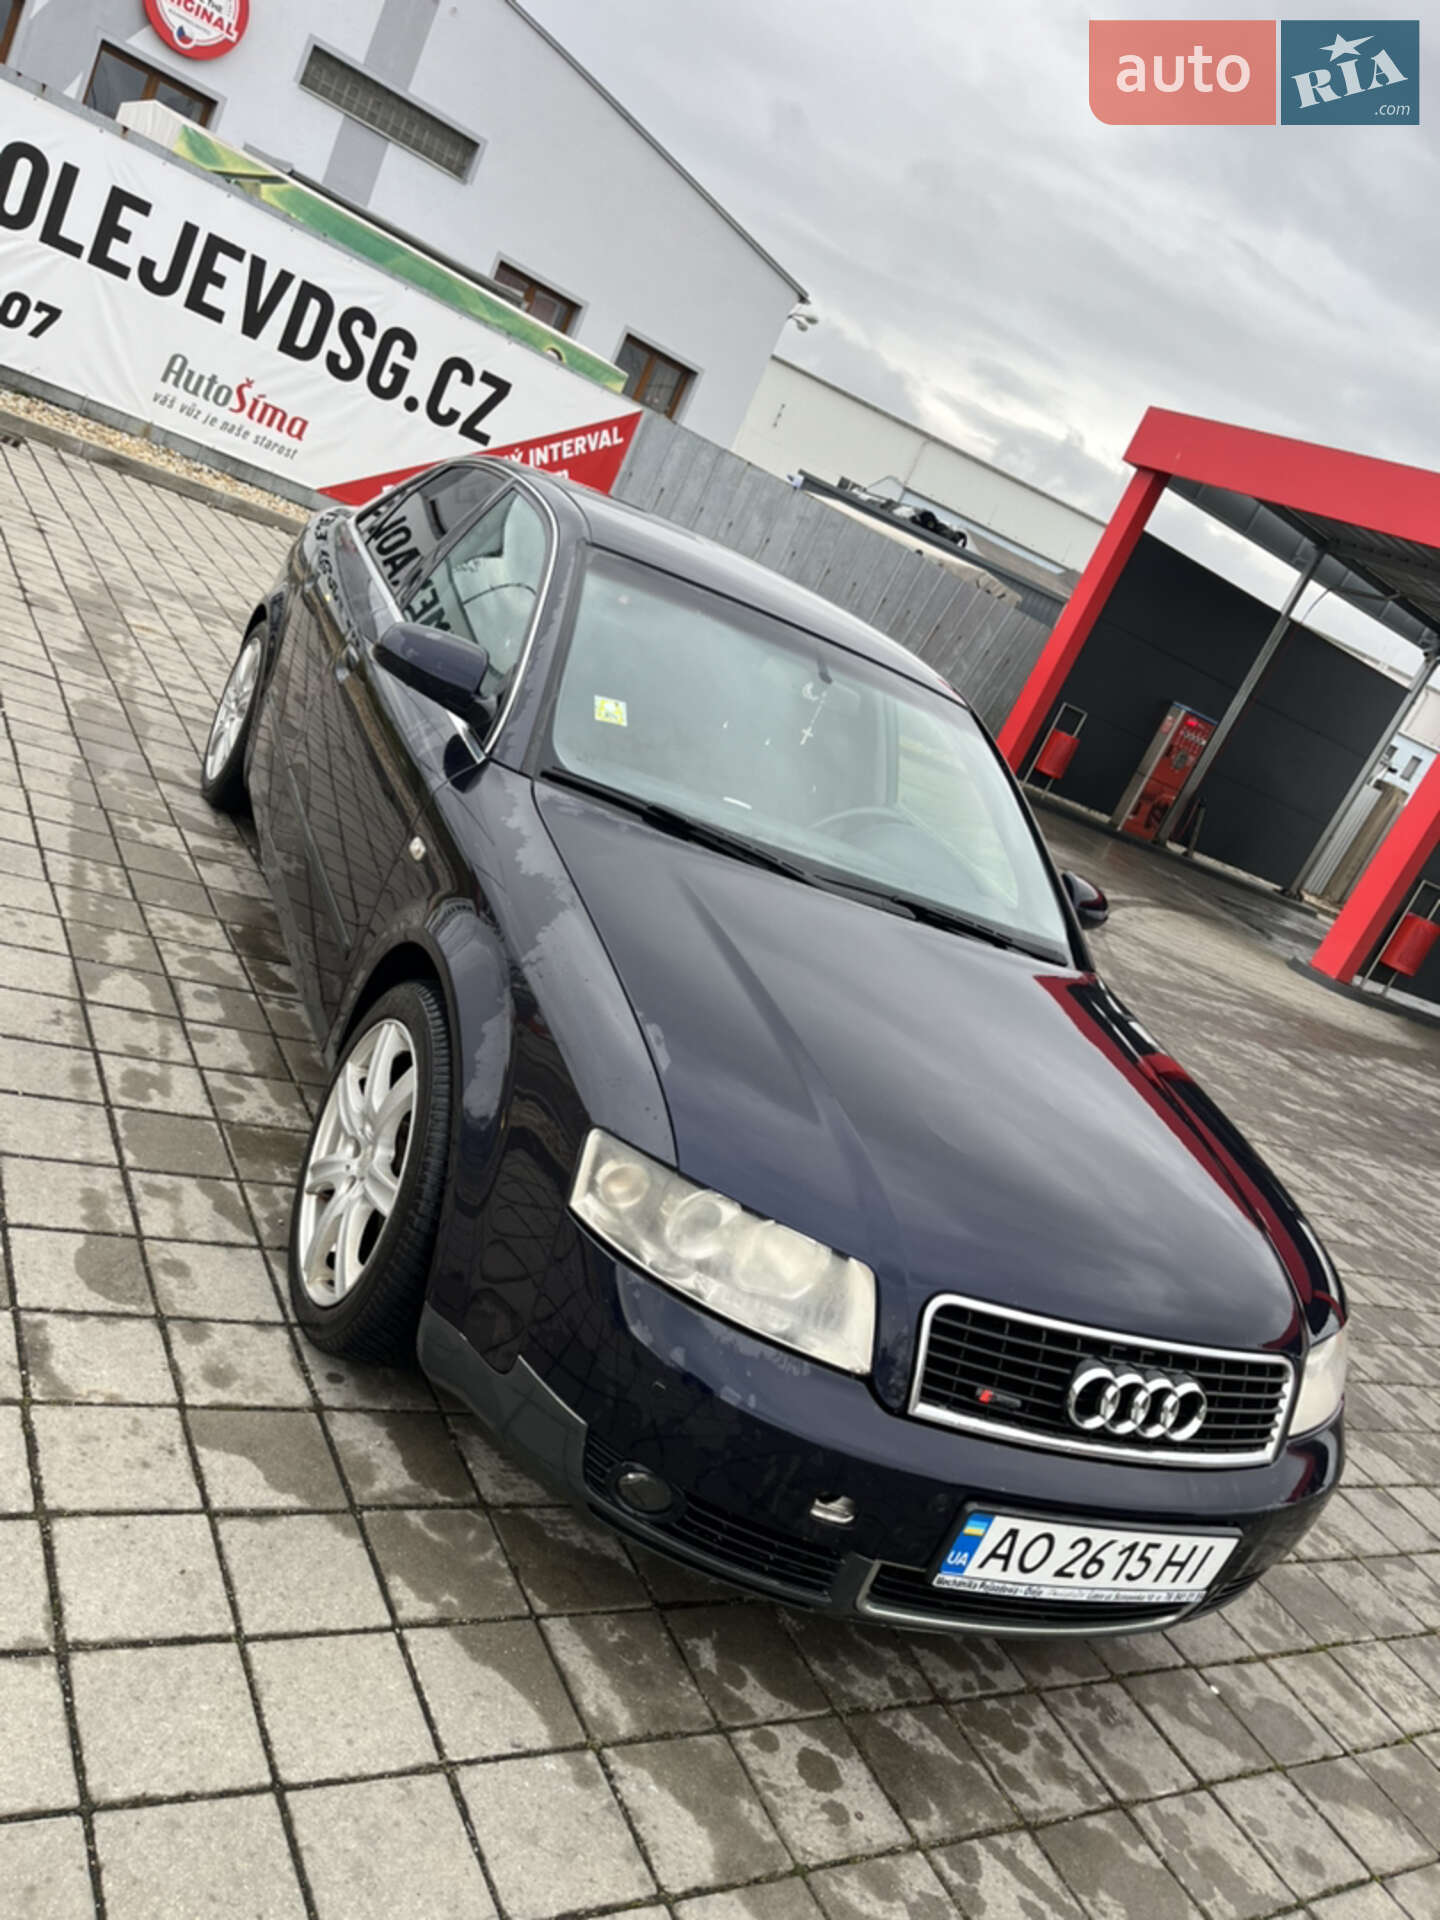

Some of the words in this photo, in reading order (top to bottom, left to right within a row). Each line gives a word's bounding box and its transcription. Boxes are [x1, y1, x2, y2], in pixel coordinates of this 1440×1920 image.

[0, 142, 512, 446] OLEJEVDSG.CZ
[0, 291, 63, 338] 07
[202, 413, 218, 427] je
[253, 434, 298, 460] starost
[529, 426, 624, 468] INTERVAL
[947, 1551, 969, 1567] UA
[978, 1528, 1056, 1575] AO
[1053, 1537, 1163, 1583] 2615
[1153, 1543, 1215, 1584] HI
